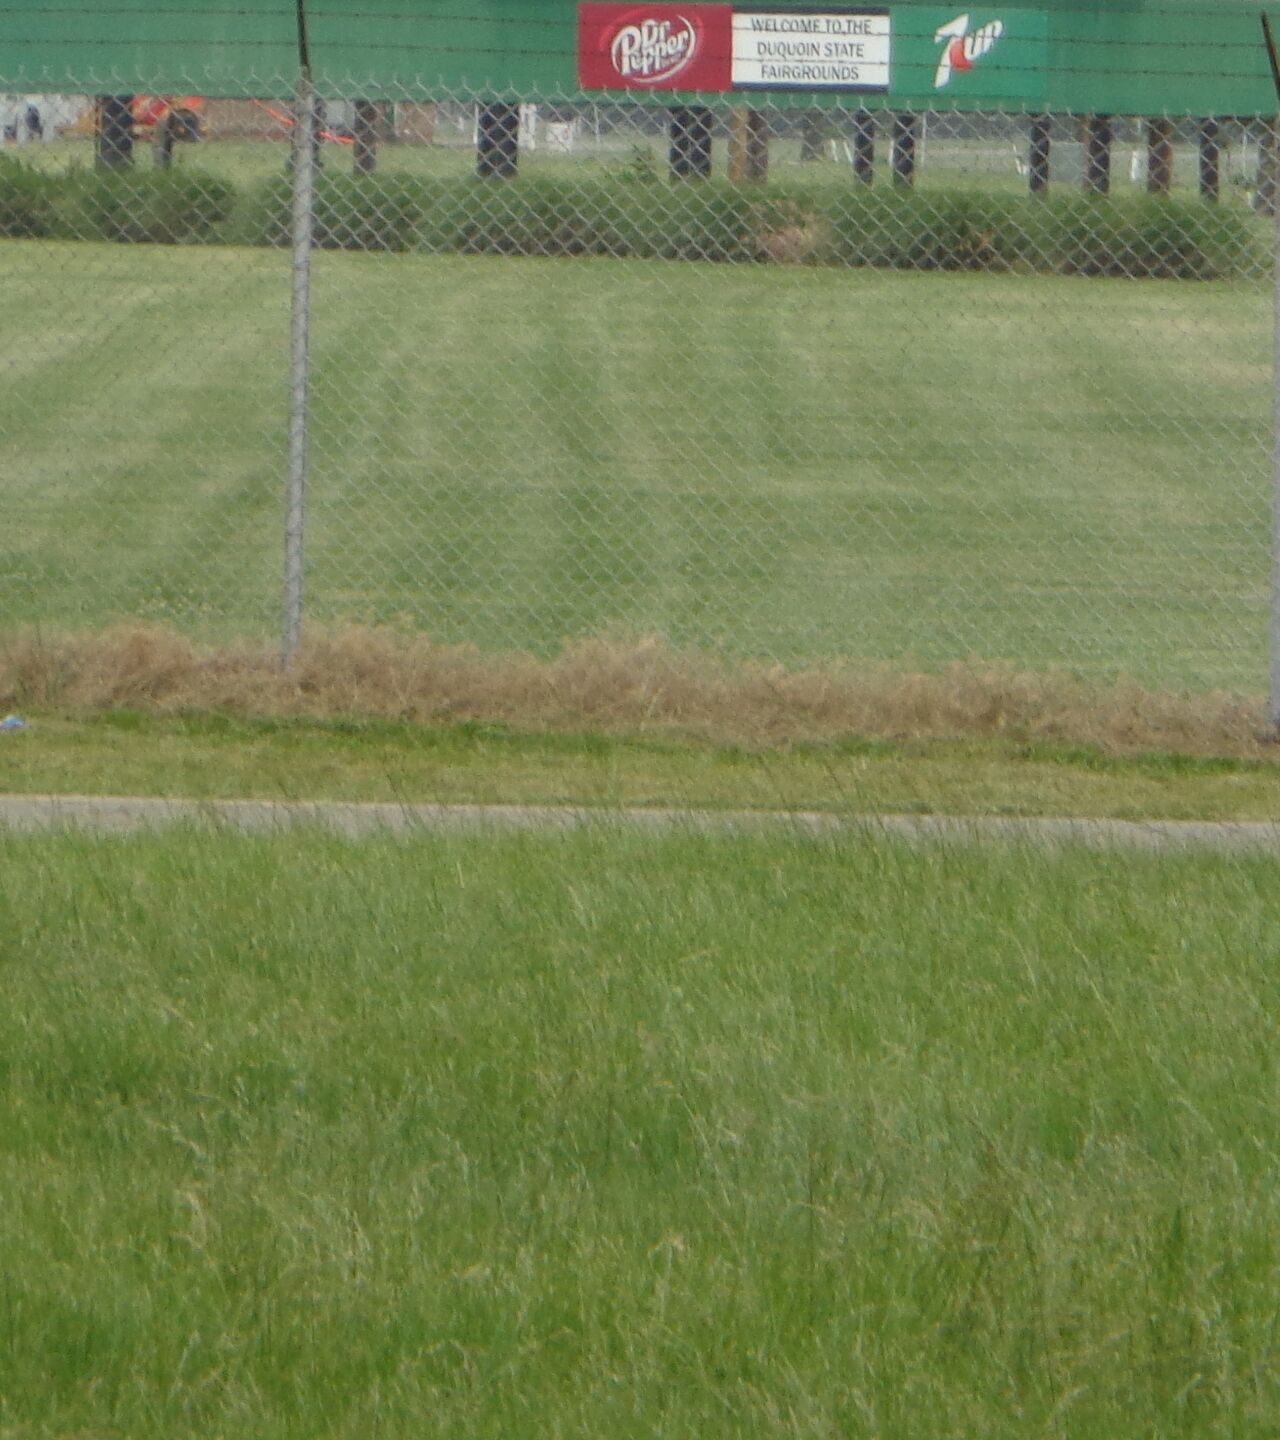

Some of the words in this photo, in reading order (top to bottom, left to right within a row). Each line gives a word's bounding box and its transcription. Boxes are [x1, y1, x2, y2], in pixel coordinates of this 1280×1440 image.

[641, 18, 671, 48] Dr
[751, 17, 821, 33] WELCOME
[825, 19, 842, 34] TO
[844, 19, 872, 35] THE
[614, 25, 689, 76] Pepper
[756, 41, 821, 60] DUQUOIN
[823, 42, 865, 58] STATE
[760, 64, 860, 81] FAIRGROUNDS
